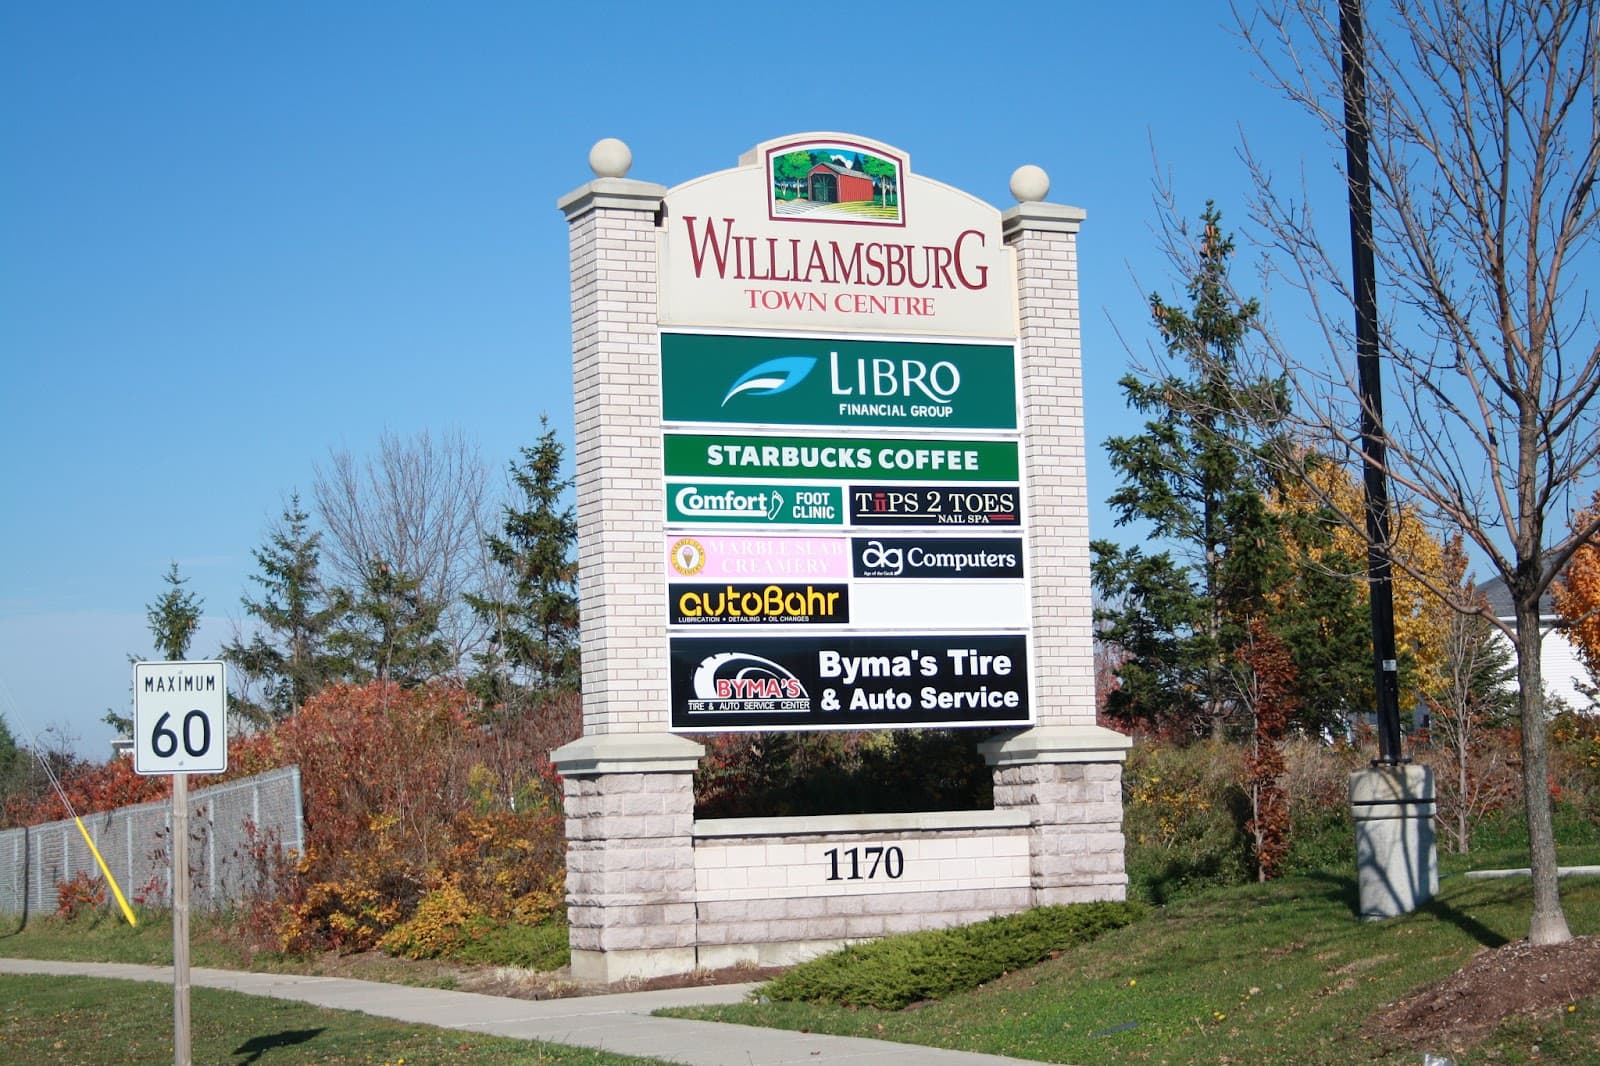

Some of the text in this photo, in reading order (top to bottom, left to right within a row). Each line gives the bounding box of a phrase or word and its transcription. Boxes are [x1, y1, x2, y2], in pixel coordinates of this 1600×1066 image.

[683, 216, 988, 290] WILLIAMSBURG
[744, 289, 936, 316] TOWN CENTRE
[830, 352, 961, 404] LIBRO
[839, 403, 953, 418] FINANCIAL GROUP
[707, 445, 979, 470] STARBUCKS COFFEE
[675, 487, 767, 517] Comfort
[796, 491, 830, 506] FOOT
[926, 491, 942, 512] 2
[949, 493, 1014, 513] TOES
[792, 505, 835, 520] CLINIC
[938, 514, 990, 524] NAIL SPA
[907, 547, 1016, 571] Computers
[818, 649, 1013, 685] Byma's Tire
[145, 675, 215, 693] MAXIMUM
[716, 678, 801, 699] BYMA'S
[688, 701, 810, 711] TIRE & AUTO SERVICE CENTER
[820, 686, 1019, 711] & Auto Service
[151, 709, 211, 758] 60
[824, 846, 905, 881] 1170
